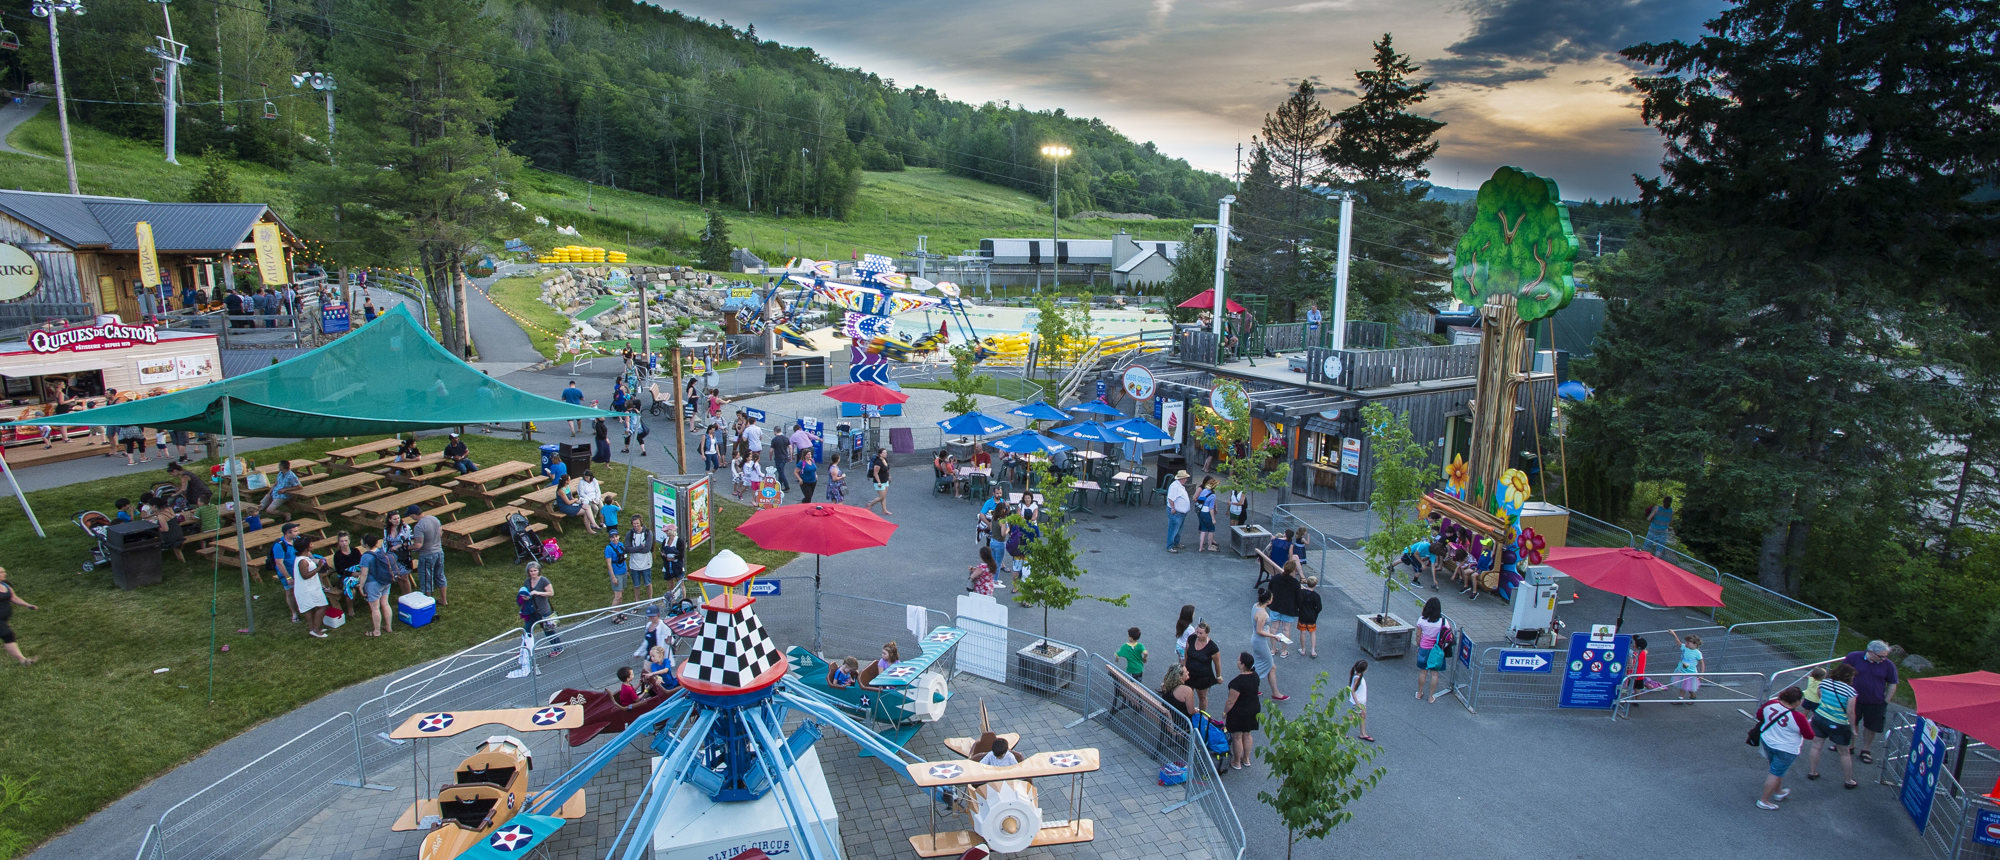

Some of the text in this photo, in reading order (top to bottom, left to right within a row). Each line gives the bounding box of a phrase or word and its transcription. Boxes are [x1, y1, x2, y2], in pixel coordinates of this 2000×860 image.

[32, 324, 157, 352] QUEUES DE CASTOR
[1510, 657, 1540, 666] ENTRÉE
[752, 840, 790, 850] CIRCUS
